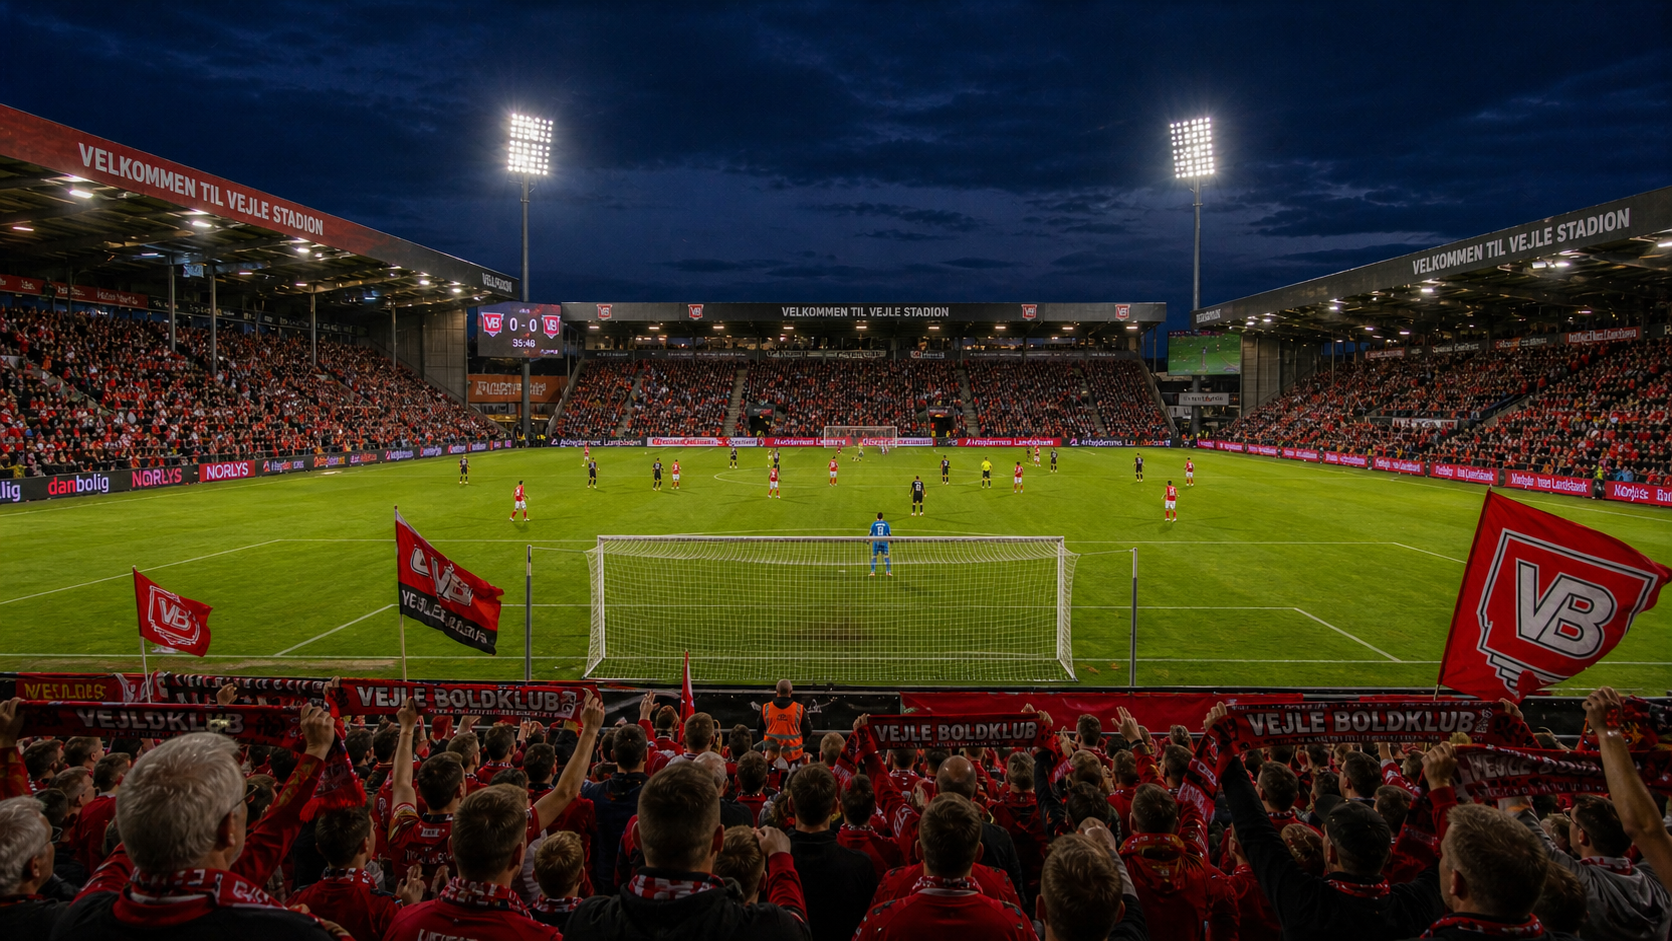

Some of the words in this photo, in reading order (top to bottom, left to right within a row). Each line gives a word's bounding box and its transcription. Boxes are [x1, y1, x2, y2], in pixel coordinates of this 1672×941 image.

[78, 142, 195, 198] VELKOMMEN
[200, 181, 224, 207] TIL
[226, 189, 269, 220] VEJLE
[273, 205, 323, 236] STADION
[1412, 244, 1483, 275] VELKOMMEN
[1486, 238, 1506, 259] TIL
[1509, 227, 1553, 253] VEJLE
[1556, 207, 1630, 243] STADION
[781, 306, 848, 317] VELKOMMEN
[850, 306, 867, 317] TIL
[869, 306, 901, 317] VEJLE
[903, 306, 949, 317] STADION
[485, 316, 500, 329] VB
[509, 317, 518, 332] 0
[529, 318, 537, 332] 0
[545, 319, 558, 331] VB
[206, 462, 249, 481] NORLYS
[0, 481, 21, 502] lig
[48, 475, 109, 495] danbolig
[158, 597, 191, 631] VB
[1515, 558, 1618, 659] VB
[356, 686, 427, 707] VEJLE
[434, 688, 559, 711] BOLDKLUB
[875, 724, 932, 742] VEJLE
[938, 721, 1037, 741] BOLDKLUB
[1247, 712, 1325, 735] VEJLE
[1334, 711, 1475, 733] BOLDKLUB
